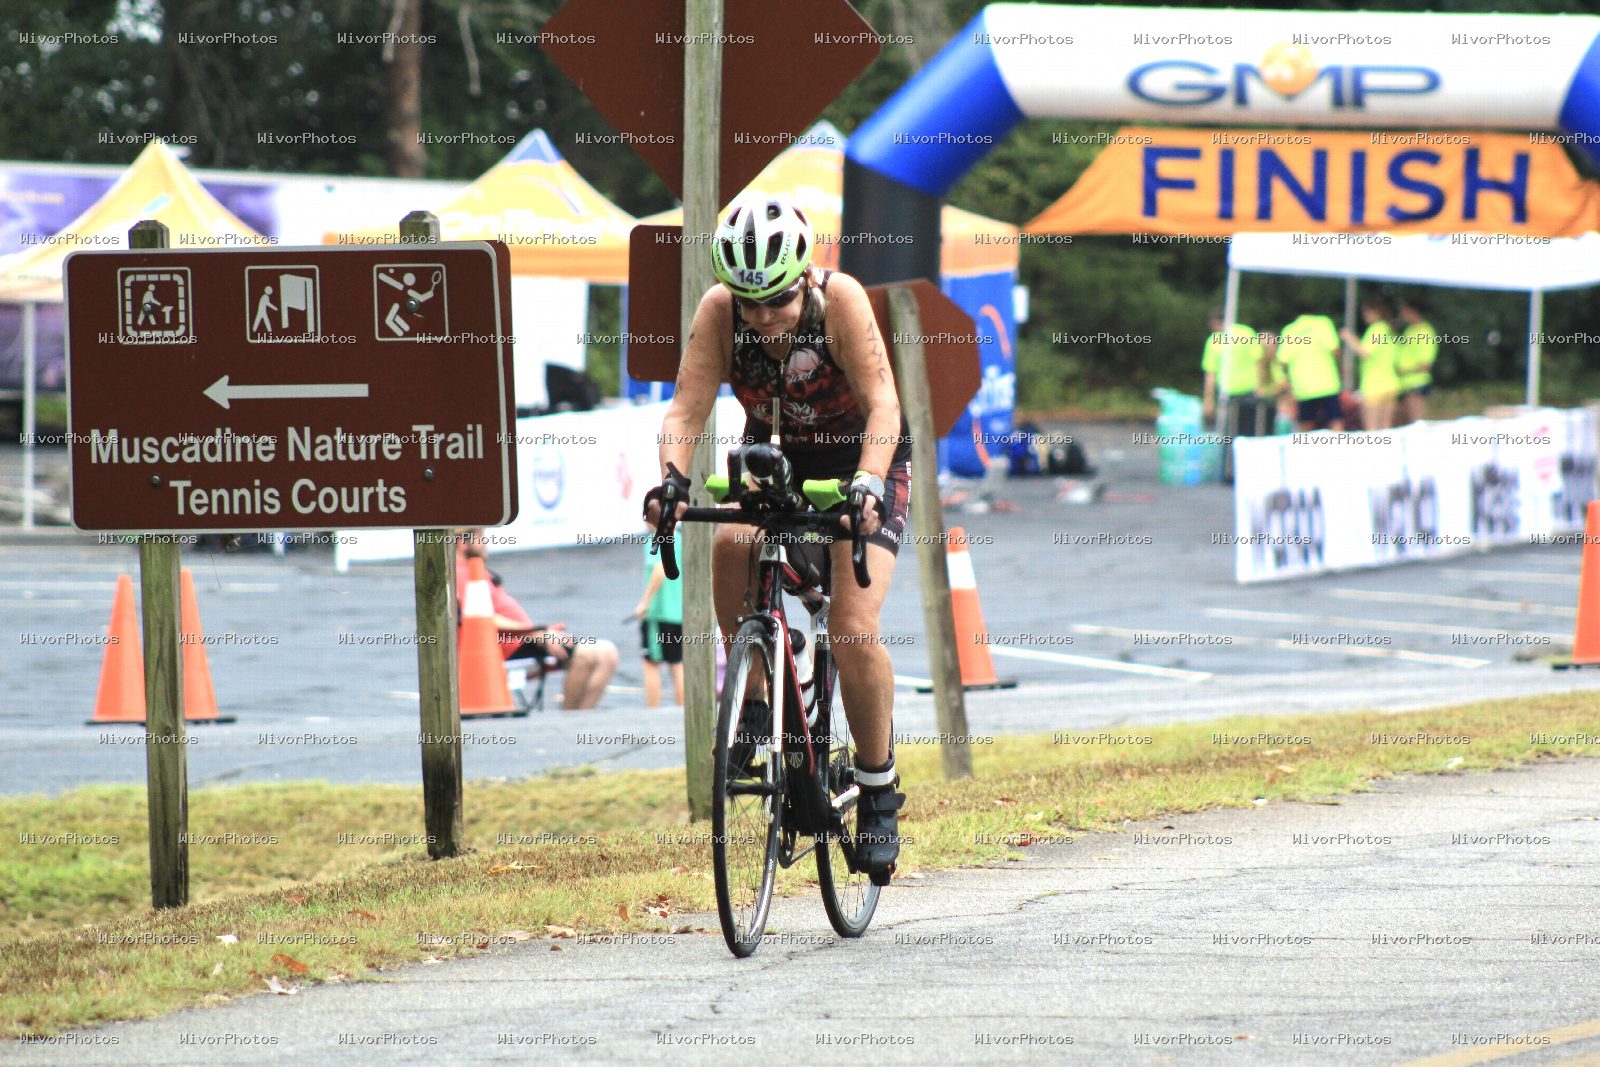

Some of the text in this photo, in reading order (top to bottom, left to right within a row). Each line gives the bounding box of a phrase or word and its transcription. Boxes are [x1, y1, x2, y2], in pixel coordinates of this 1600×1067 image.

[1127, 59, 1442, 109] GMP
[1142, 146, 1530, 224] FINISH
[738, 270, 764, 285] 145
[90, 424, 484, 463] Muscadine Nature Trail
[169, 479, 407, 515] Tennis Courts
